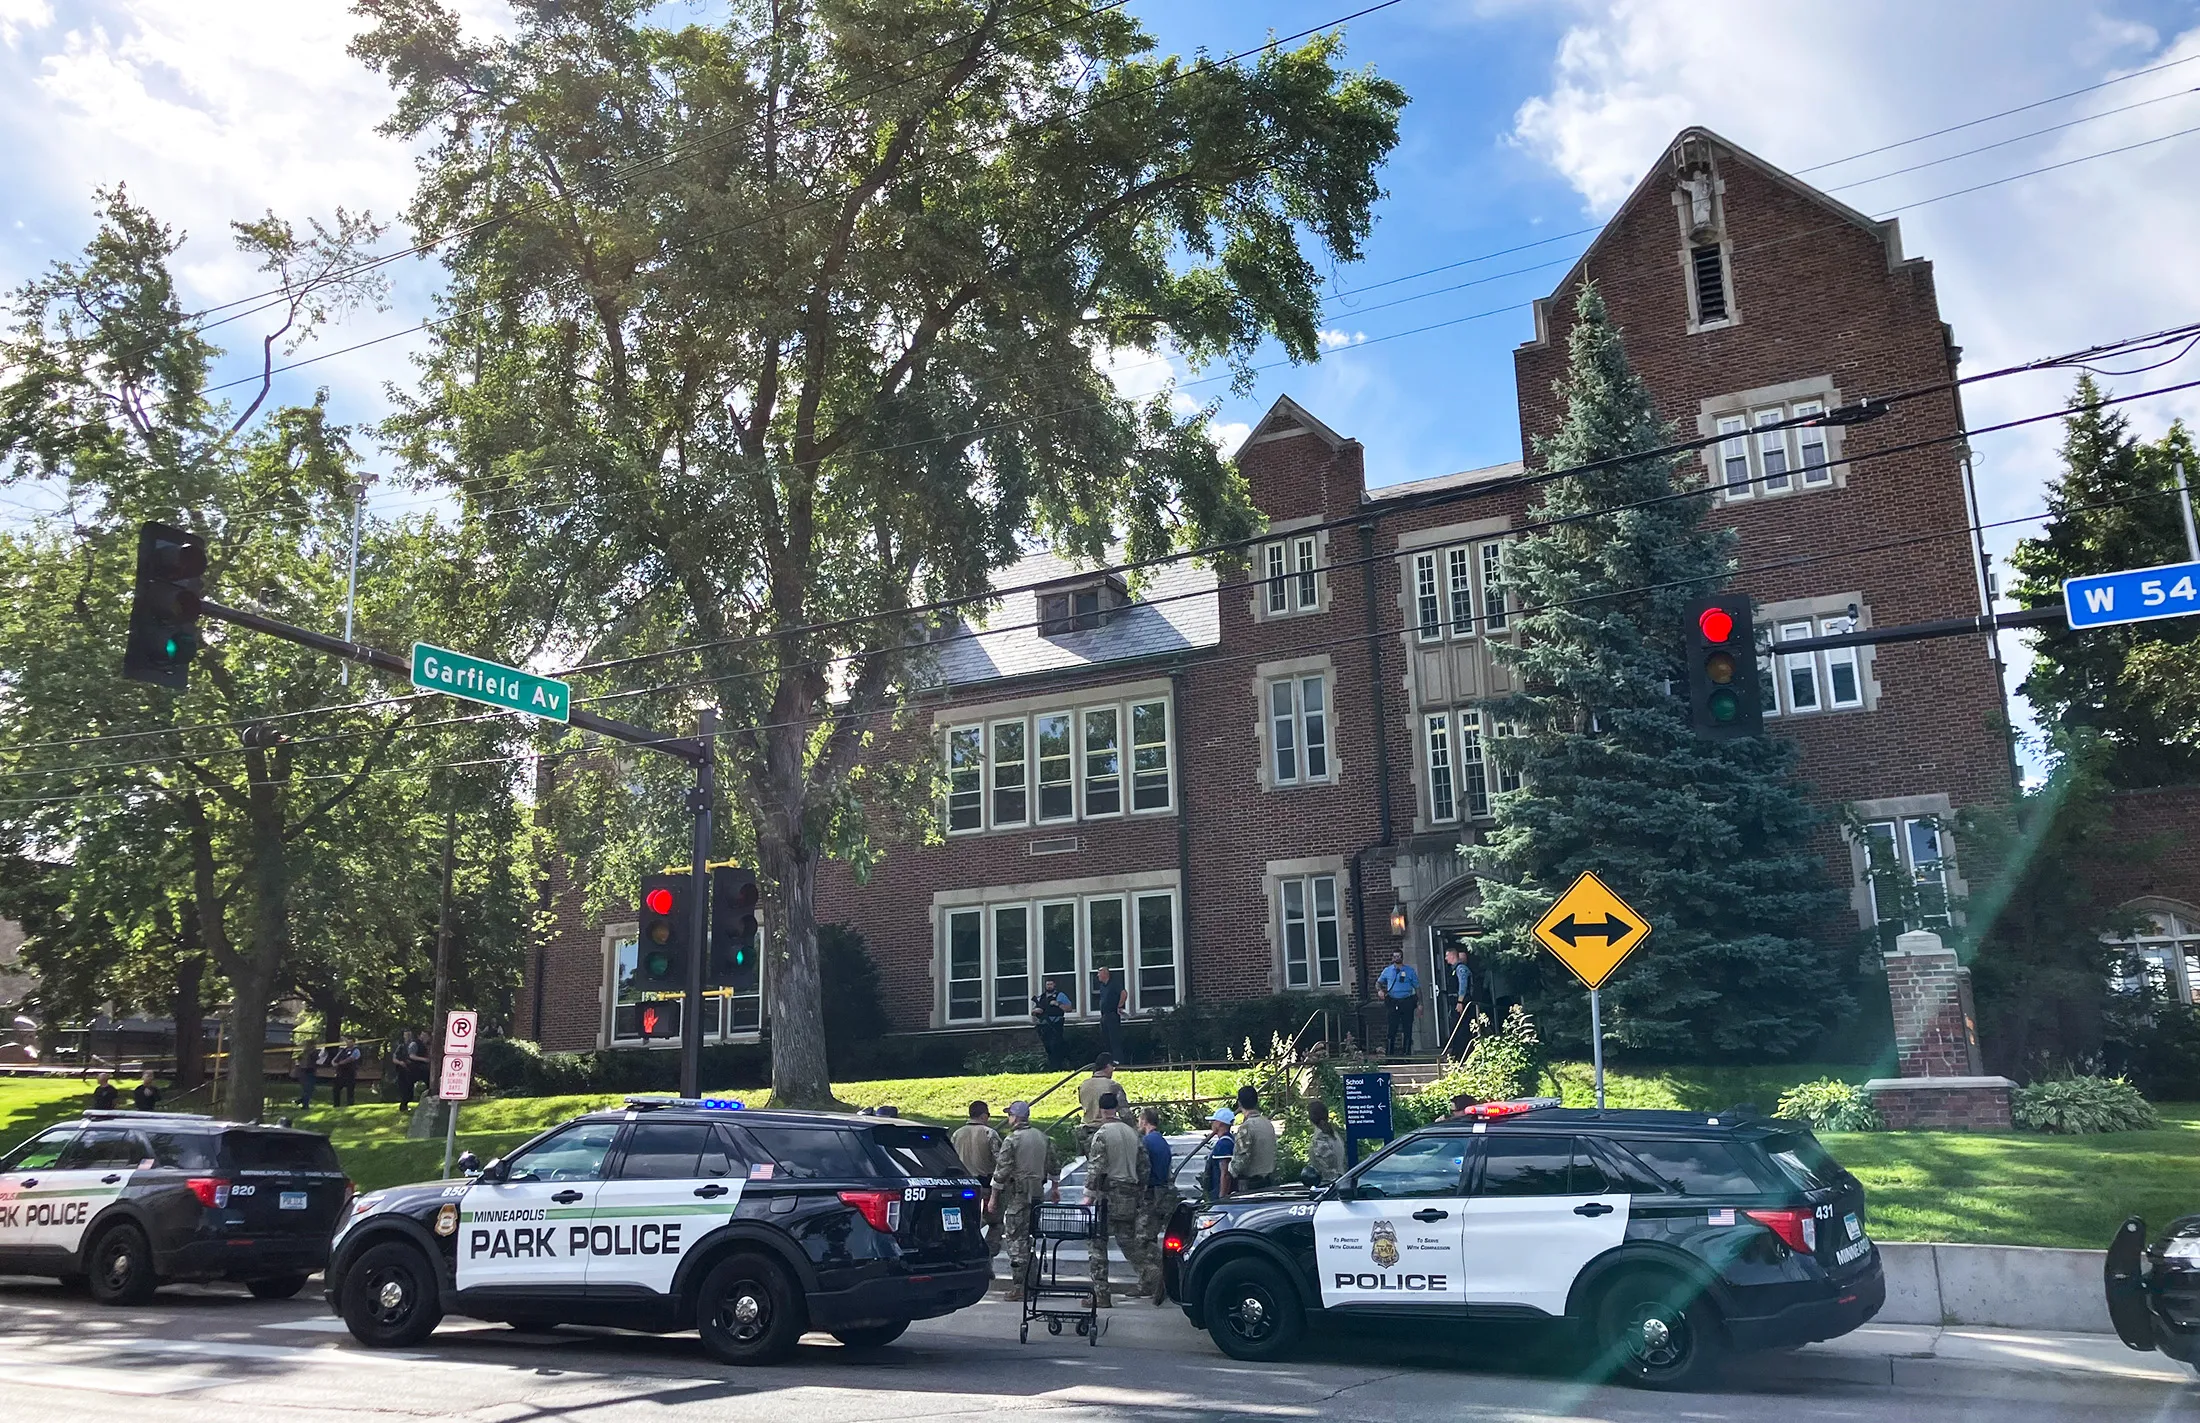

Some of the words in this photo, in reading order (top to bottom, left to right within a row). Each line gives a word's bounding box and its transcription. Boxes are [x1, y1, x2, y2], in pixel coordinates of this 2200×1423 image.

[2084, 586, 2114, 613] W
[2141, 576, 2197, 606] 54
[423, 656, 520, 701] Garfield
[531, 686, 560, 710] Av
[231, 1185, 256, 1196] 820
[442, 1186, 468, 1197] 850
[904, 1188, 926, 1201] 850
[26, 1202, 89, 1227] POLICE
[473, 1209, 545, 1223] MINNEAPOLIS
[1288, 1204, 1315, 1216] 431
[1815, 1203, 1834, 1220] 431
[470, 1227, 557, 1259] PARK
[569, 1223, 682, 1257] POLICE
[1334, 1273, 1447, 1291] POLICE
